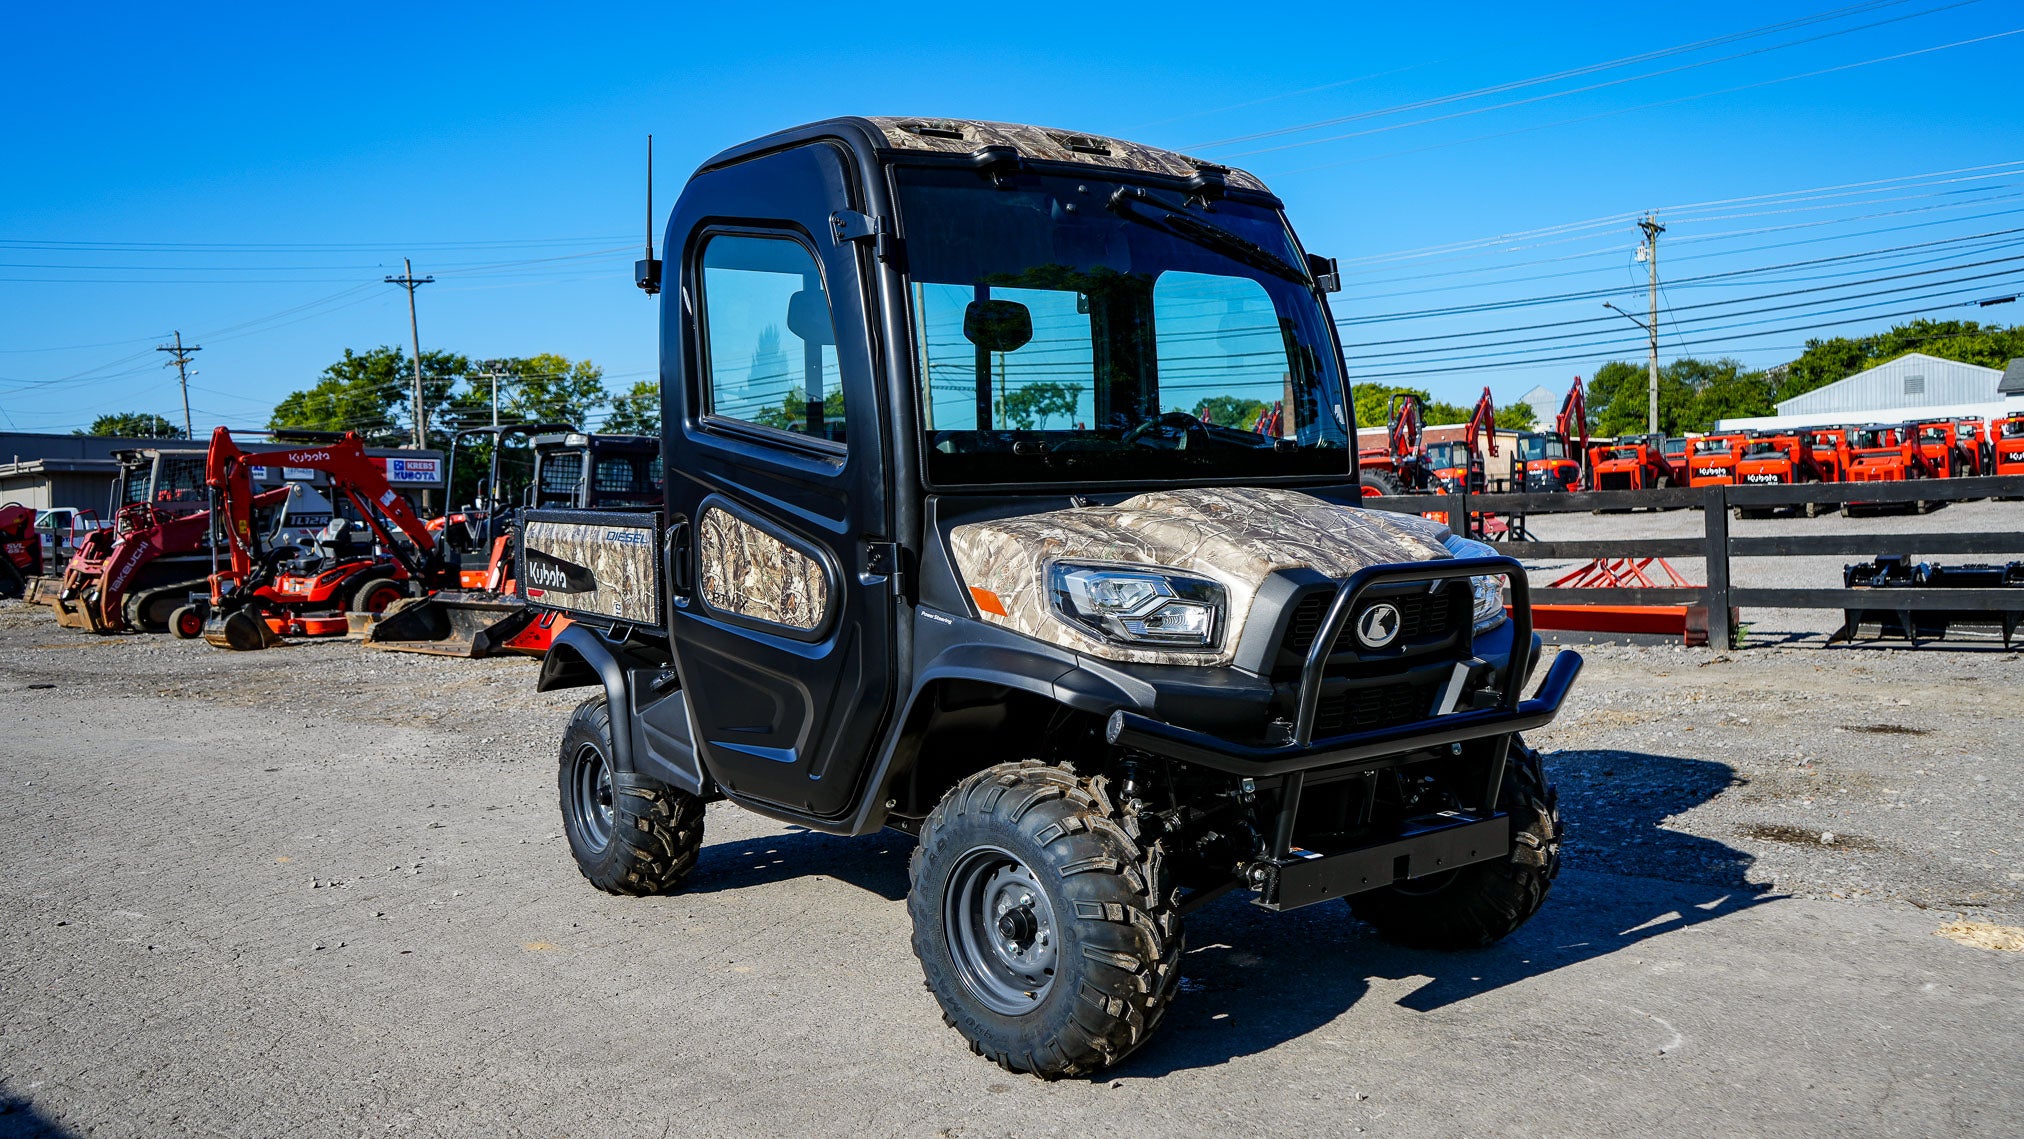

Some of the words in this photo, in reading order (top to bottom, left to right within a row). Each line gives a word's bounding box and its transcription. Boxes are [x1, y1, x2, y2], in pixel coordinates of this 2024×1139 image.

[288, 451, 330, 463] Kubota
[406, 462, 433, 470] KREBS
[1699, 466, 1727, 475] Kubota
[393, 471, 435, 480] KUBOTA
[1747, 474, 1778, 483] Kubota
[606, 531, 648, 544] DIESEL
[529, 561, 567, 589] Kubota
[920, 610, 933, 619] Power
[933, 614, 953, 625] Steering
